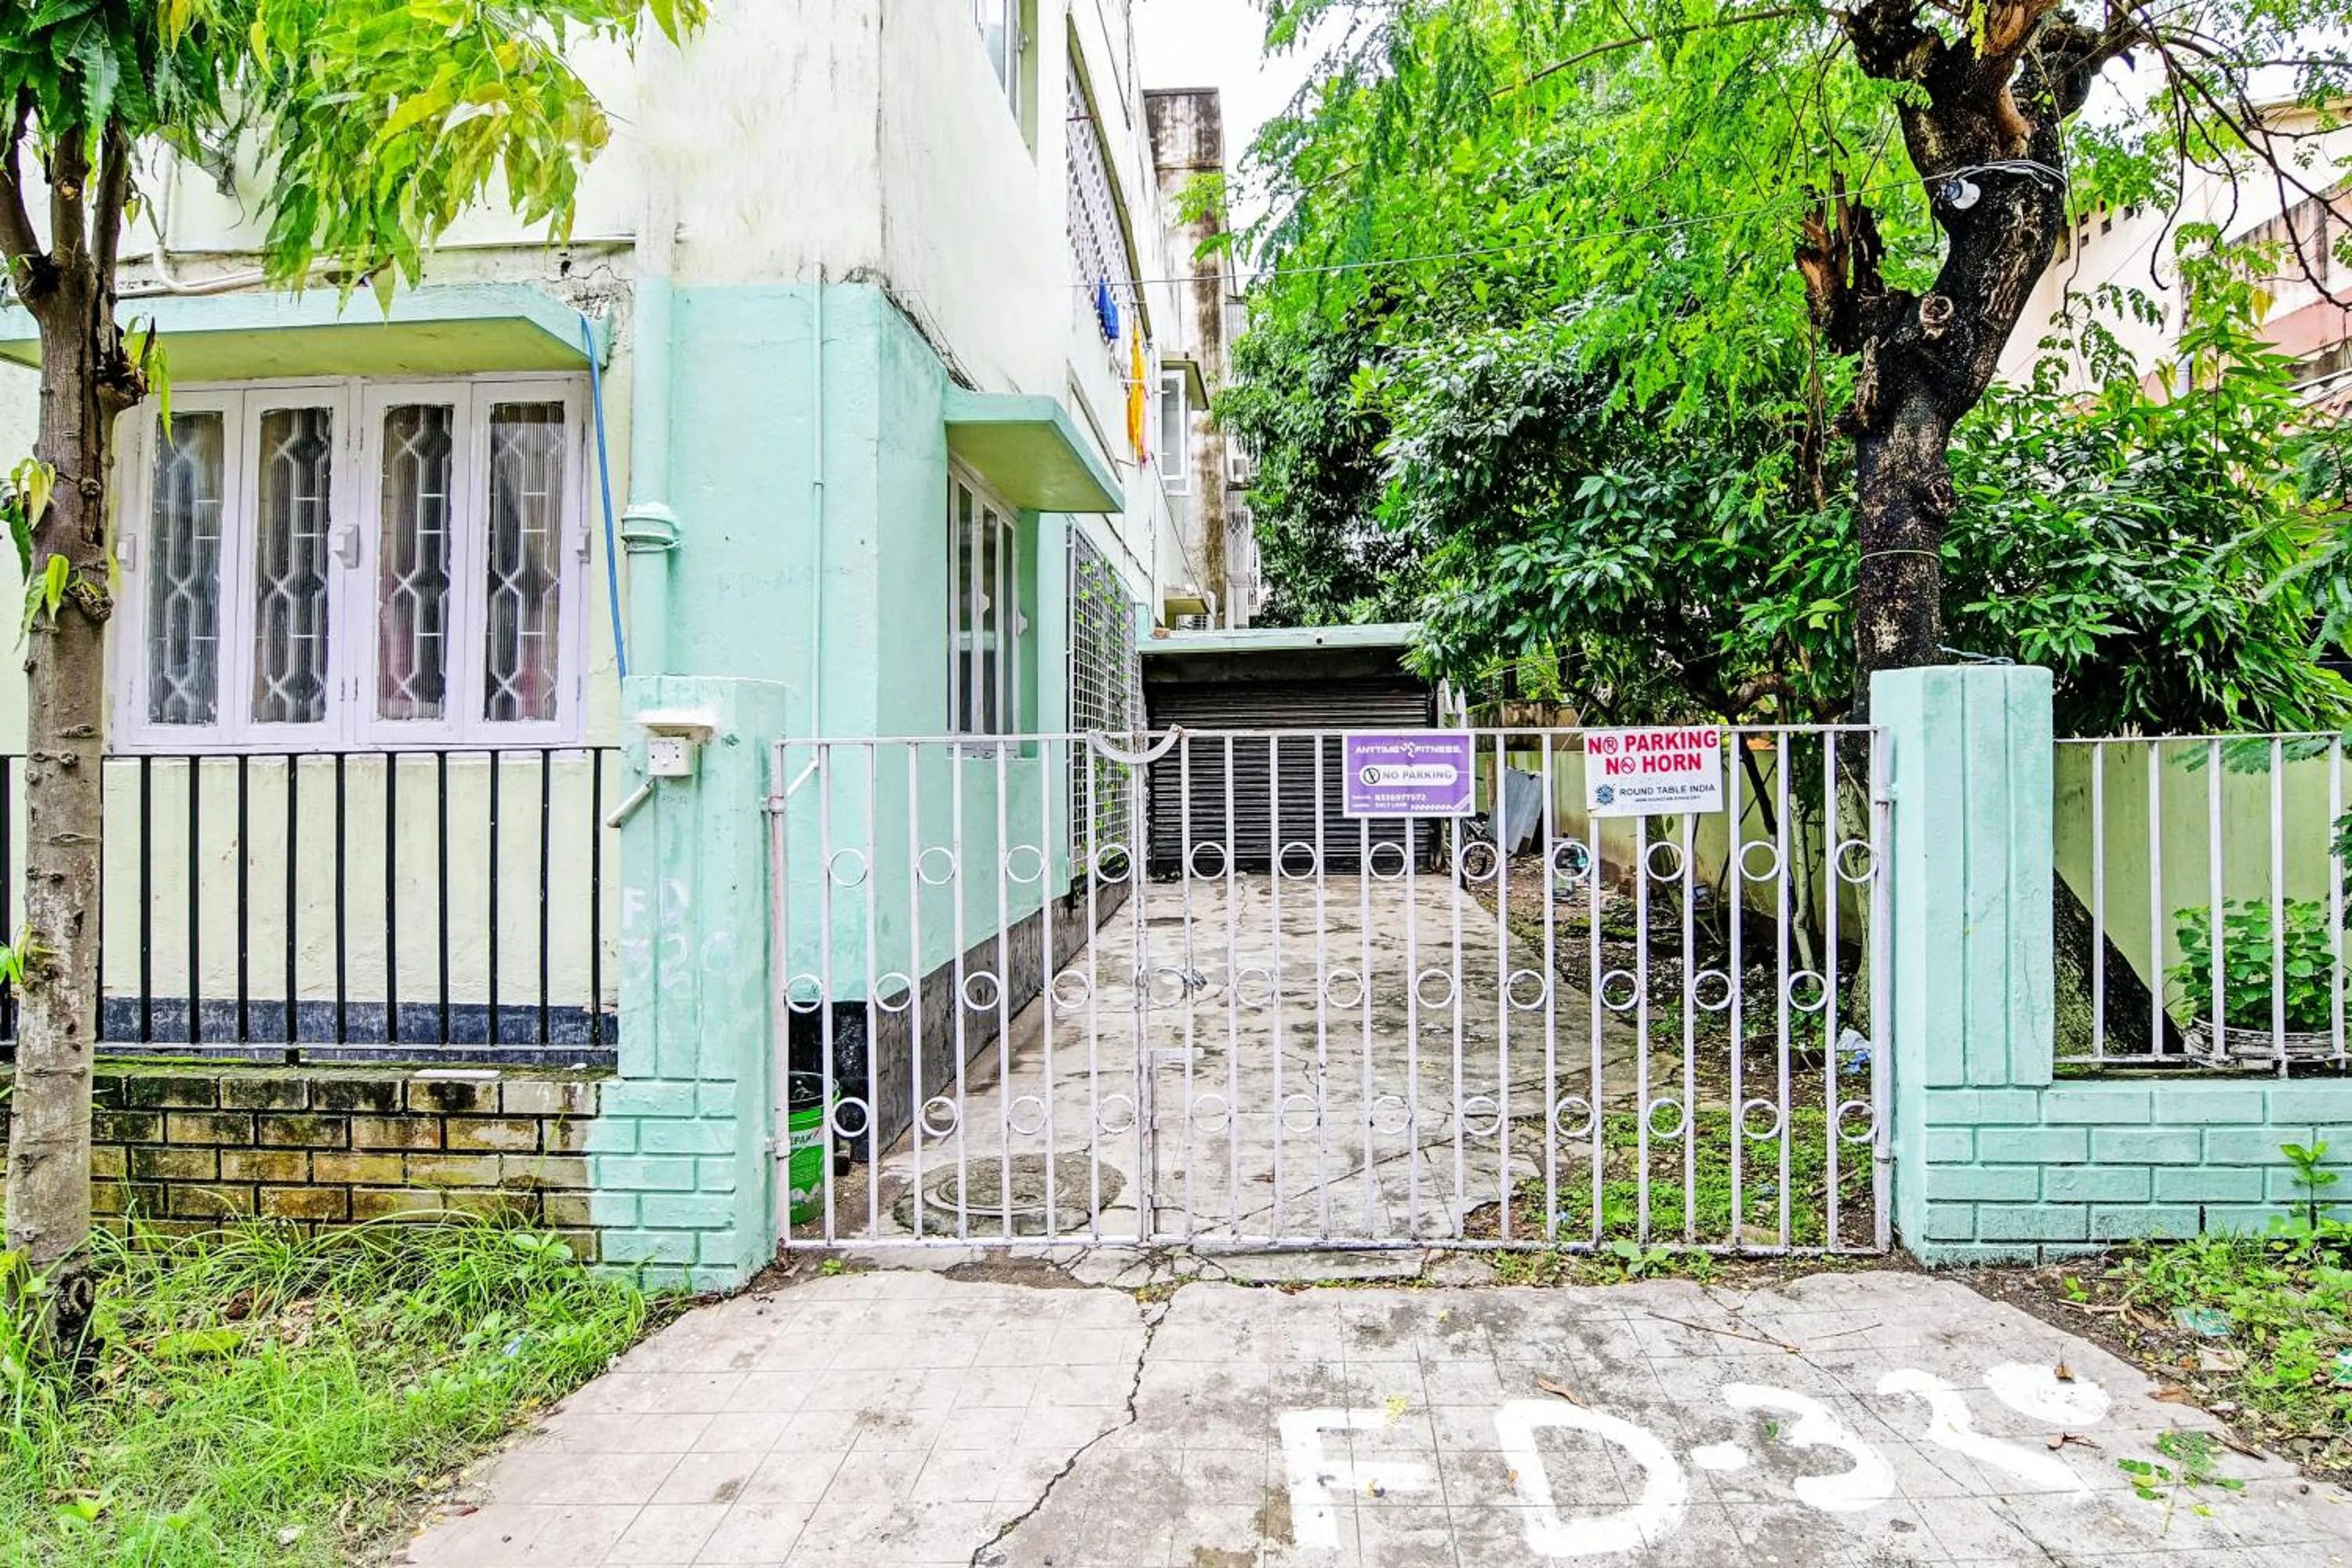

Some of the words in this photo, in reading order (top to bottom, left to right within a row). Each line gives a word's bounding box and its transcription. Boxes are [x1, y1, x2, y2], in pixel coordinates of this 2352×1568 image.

[1624, 730, 1718, 753] PARKING
[1642, 753, 1702, 773] HORN
[1382, 770, 1399, 779] NO
[1403, 770, 1453, 779] PARKING
[1620, 786, 1653, 796] ROUND
[1657, 785, 1687, 794] TABLE
[1690, 783, 1716, 793] INDIA
